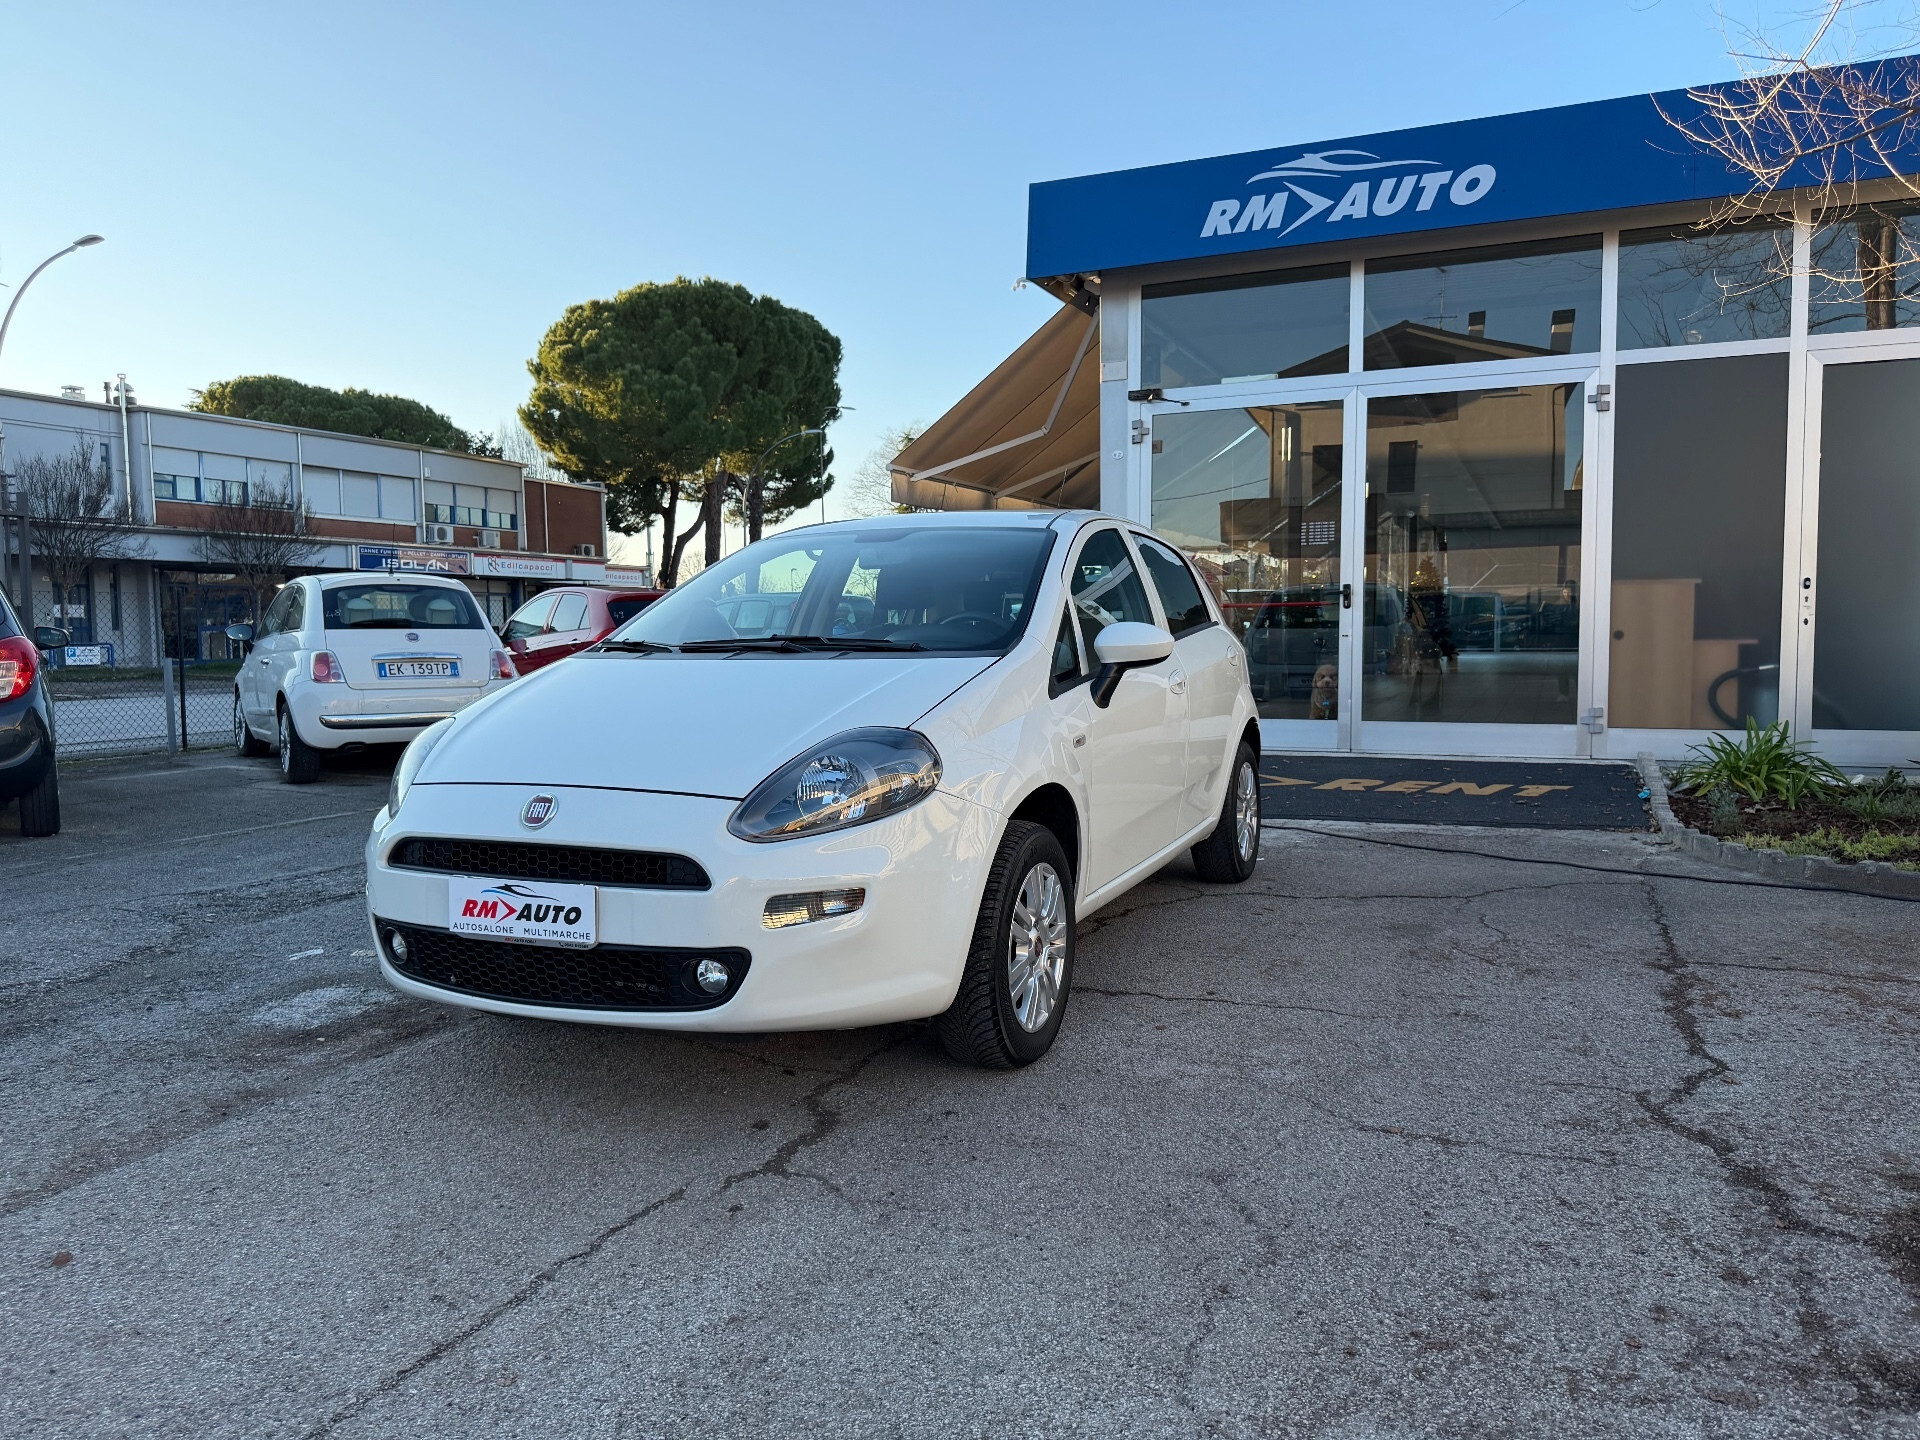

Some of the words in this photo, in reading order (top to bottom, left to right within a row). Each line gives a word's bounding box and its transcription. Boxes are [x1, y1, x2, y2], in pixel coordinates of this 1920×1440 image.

[1326, 164, 1497, 223] AUTO
[382, 558, 449, 572] ISOLAN
[501, 561, 553, 572] Edilcapacci
[605, 573, 640, 581] dilcapacci
[1312, 778, 1574, 797] RENT
[527, 802, 551, 818] FIAT
[515, 903, 582, 925] AUTO
[453, 922, 514, 934] AUTOSALONE
[523, 928, 591, 941] MULTIMARCHE
